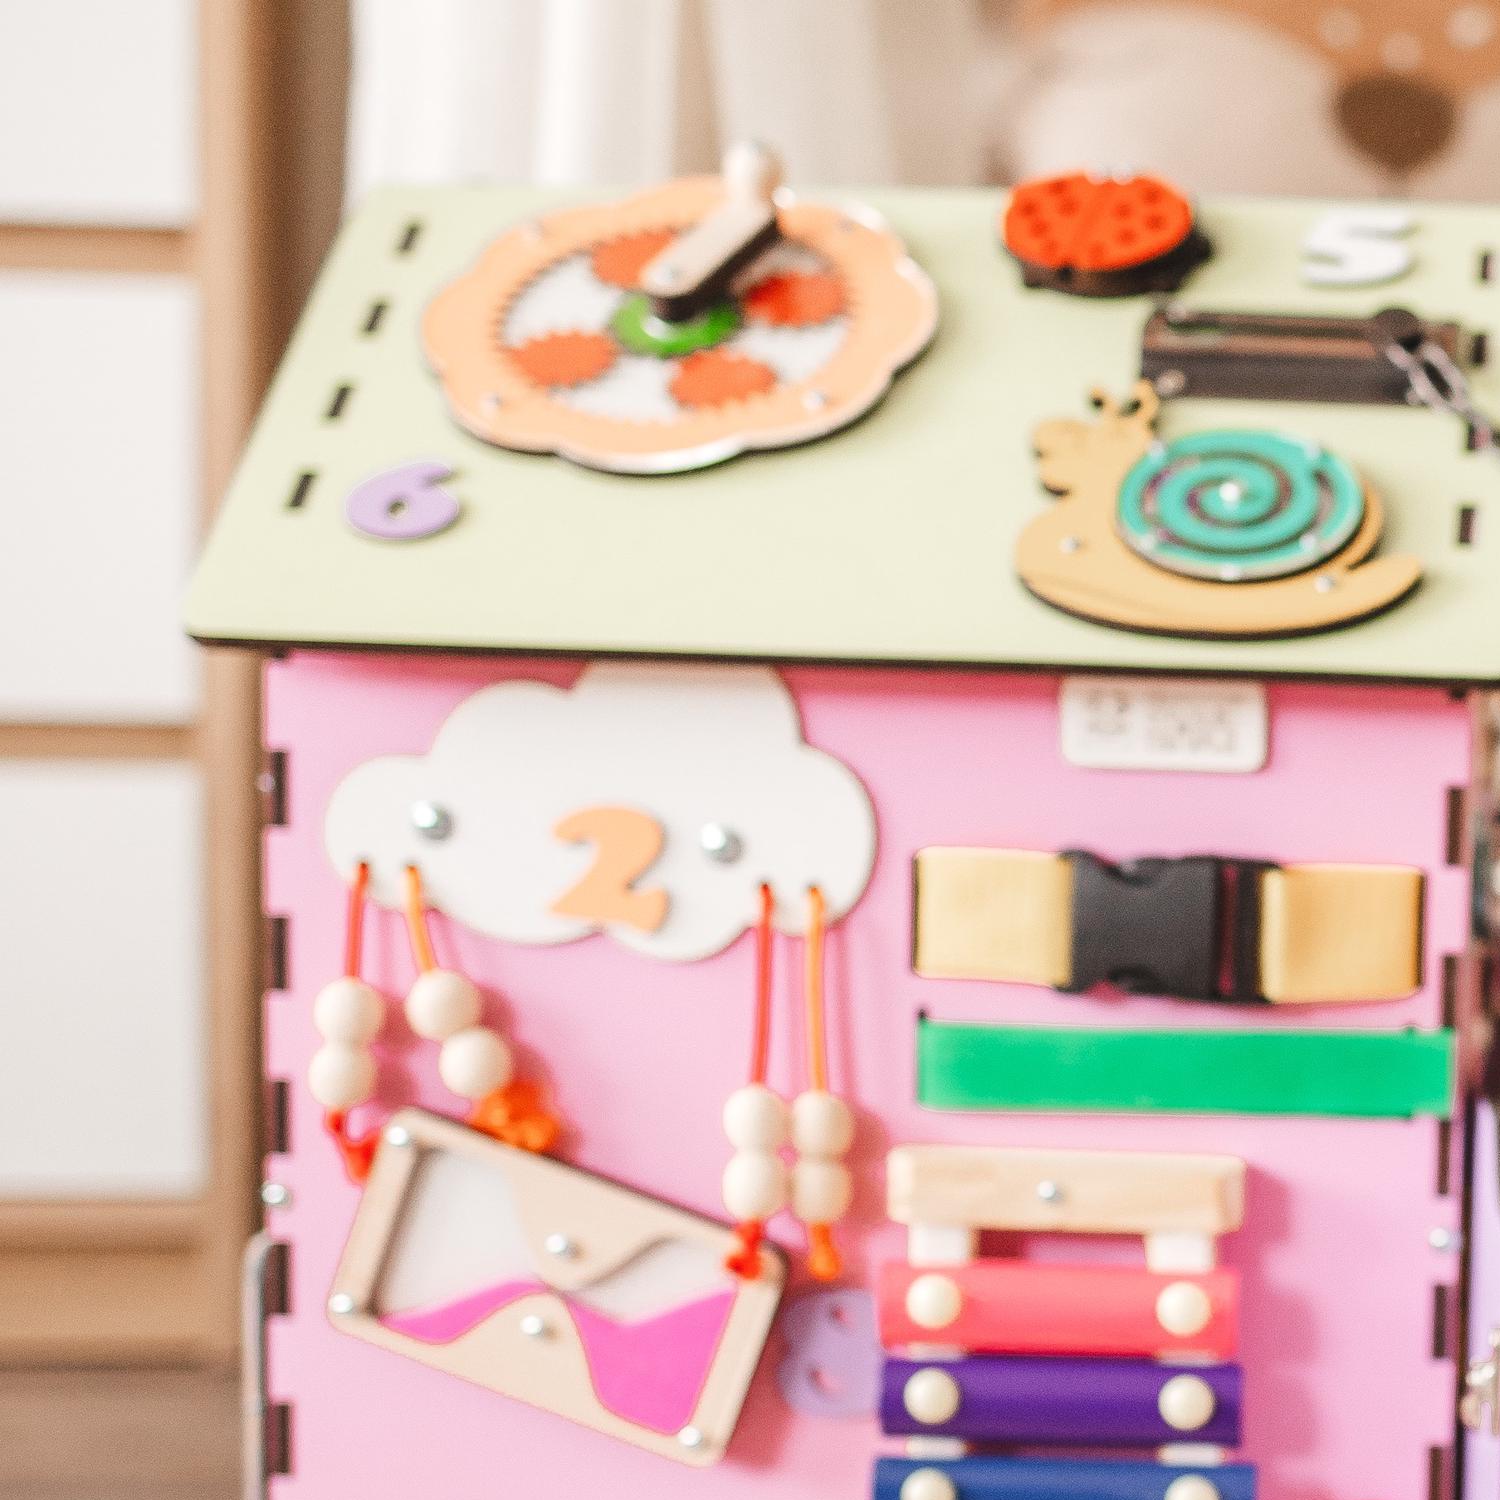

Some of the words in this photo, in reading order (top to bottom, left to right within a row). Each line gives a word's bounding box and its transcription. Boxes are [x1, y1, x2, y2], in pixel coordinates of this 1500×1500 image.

[1301, 208, 1411, 282] 5
[344, 459, 459, 540] 6
[551, 805, 669, 934] 2
